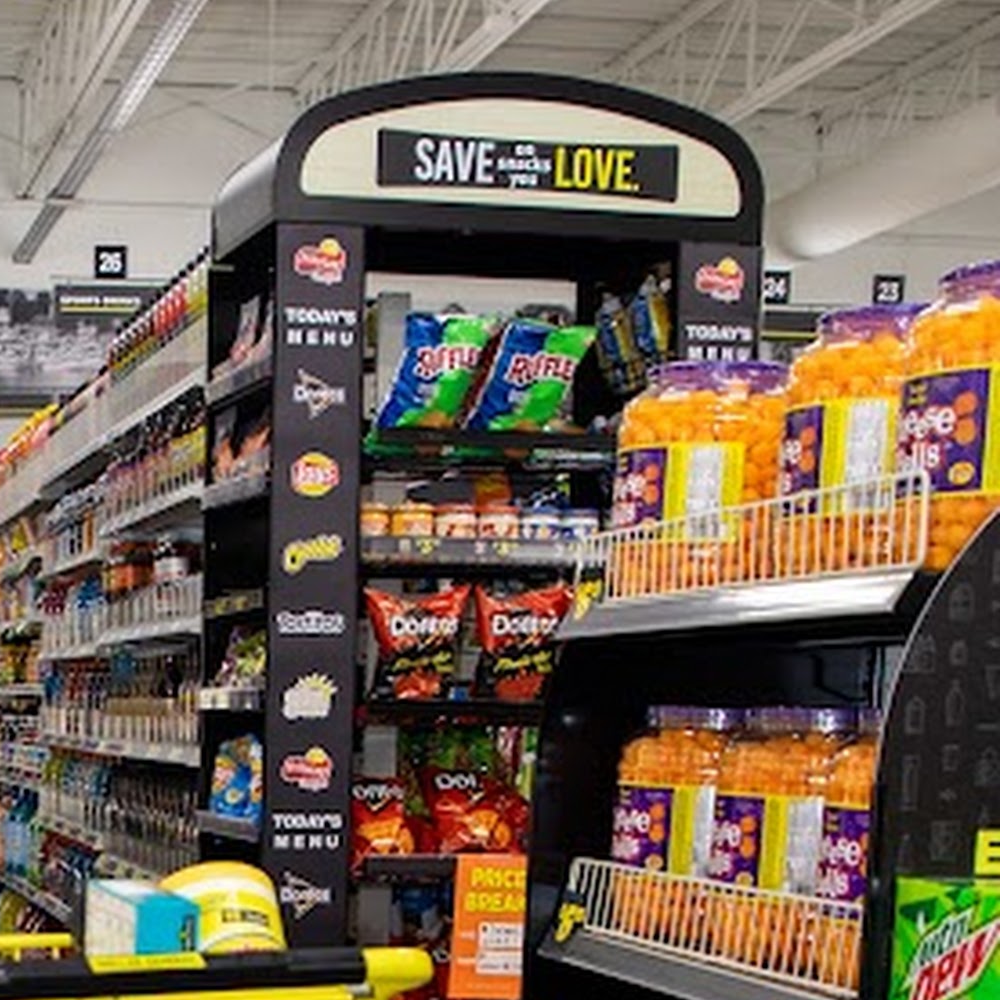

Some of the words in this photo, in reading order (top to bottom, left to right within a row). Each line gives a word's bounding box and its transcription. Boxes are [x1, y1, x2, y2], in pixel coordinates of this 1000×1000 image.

[415, 138, 495, 183] SAVE
[498, 157, 551, 173] snacks
[555, 146, 639, 192] LOVE.
[509, 174, 537, 188] you
[285, 308, 356, 325] TODAY'S
[287, 330, 354, 346] MENU
[685, 325, 752, 341] TODAY'S
[273, 813, 343, 829] TODAY'S
[274, 834, 340, 849] MENU
